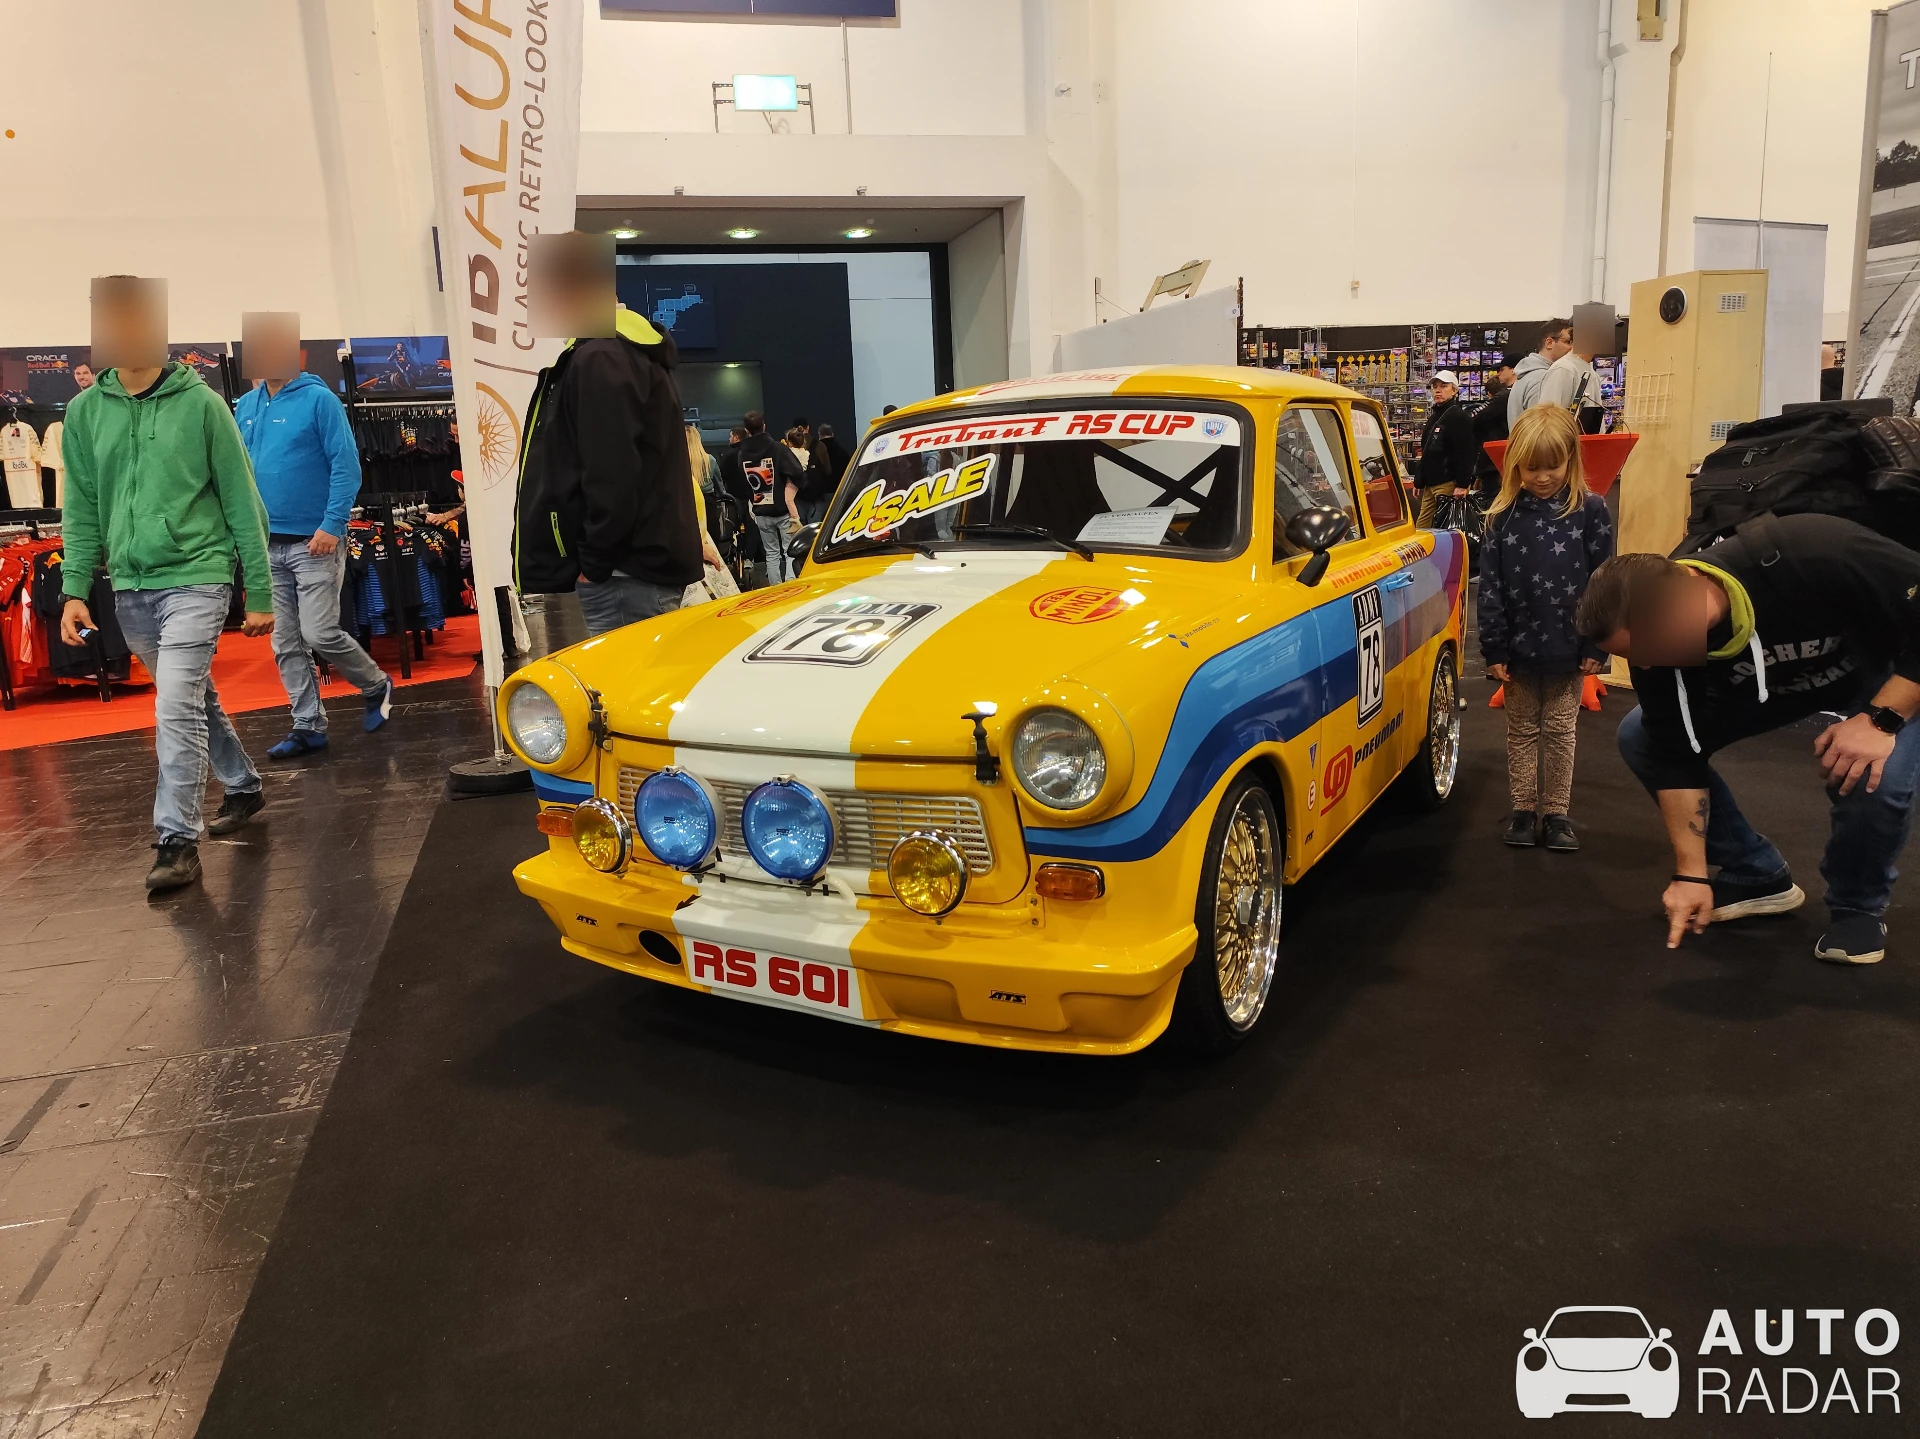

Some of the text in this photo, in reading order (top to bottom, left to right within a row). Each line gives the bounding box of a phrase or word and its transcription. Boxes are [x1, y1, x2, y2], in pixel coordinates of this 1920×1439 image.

[899, 417, 1059, 452] Trabant
[1066, 414, 1118, 435] RS
[1118, 413, 1196, 436] CUP
[1046, 590, 1113, 621] MINOL
[782, 618, 885, 653] 78
[1362, 629, 1381, 706] 78
[693, 940, 850, 1009] RS 601
[988, 991, 1027, 1003] ATS
